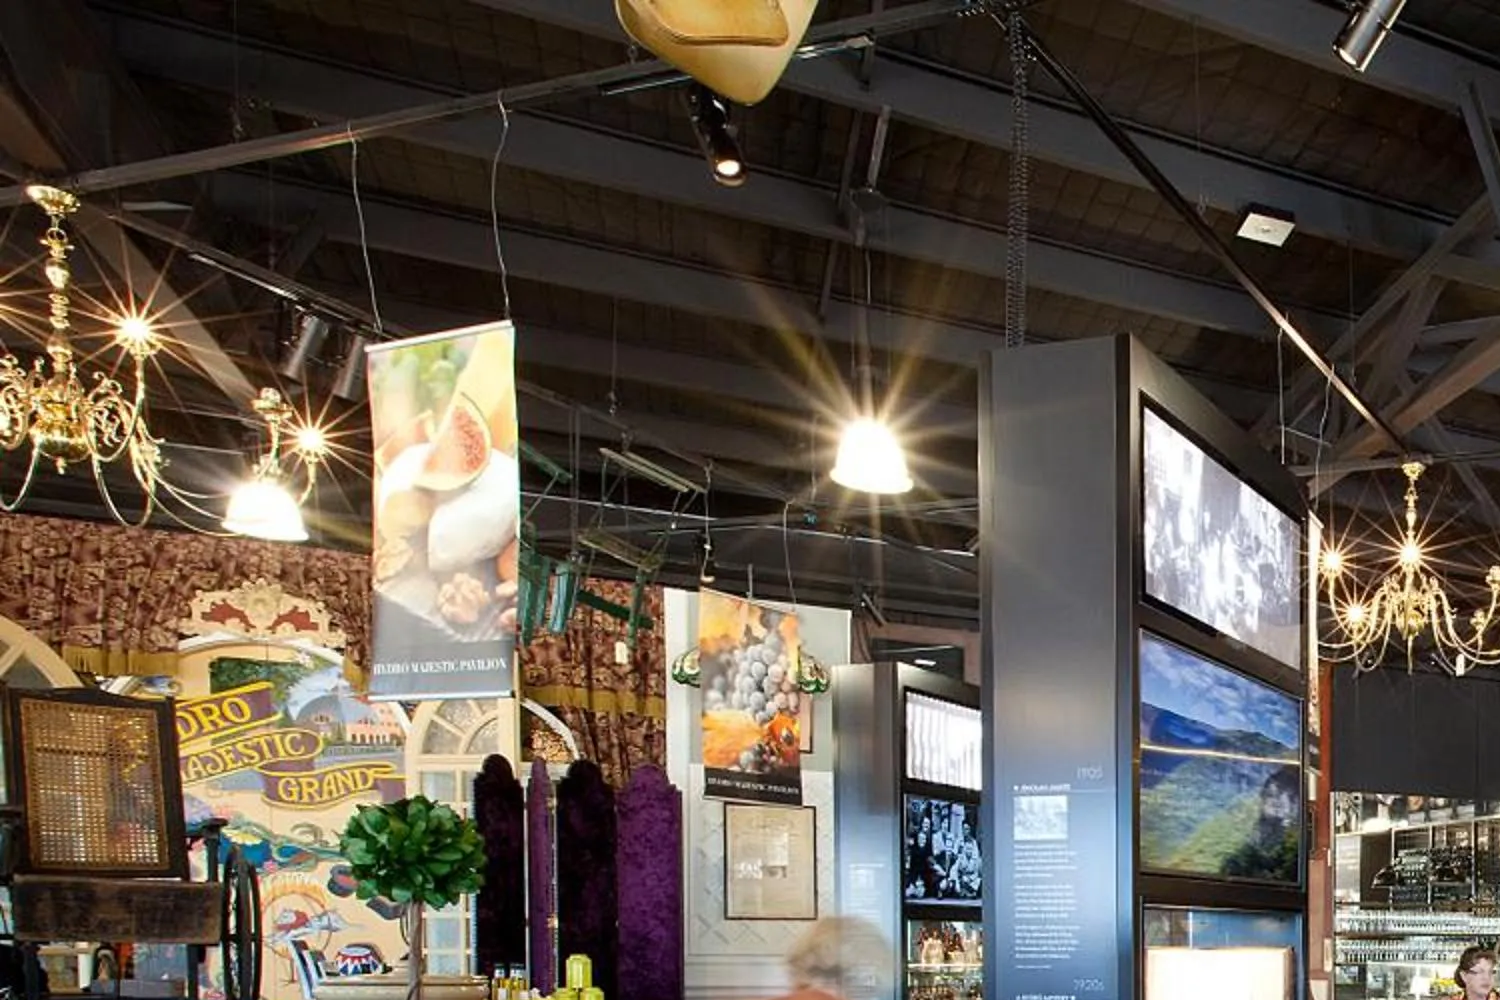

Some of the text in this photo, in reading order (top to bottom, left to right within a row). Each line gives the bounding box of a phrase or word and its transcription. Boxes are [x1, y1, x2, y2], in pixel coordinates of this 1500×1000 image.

[411, 660, 459, 673] MAJESTIC
[460, 657, 507, 671] PAVILION
[175, 696, 252, 741] DRO
[181, 732, 306, 781] AJESTIC
[277, 766, 375, 802] GRAND
